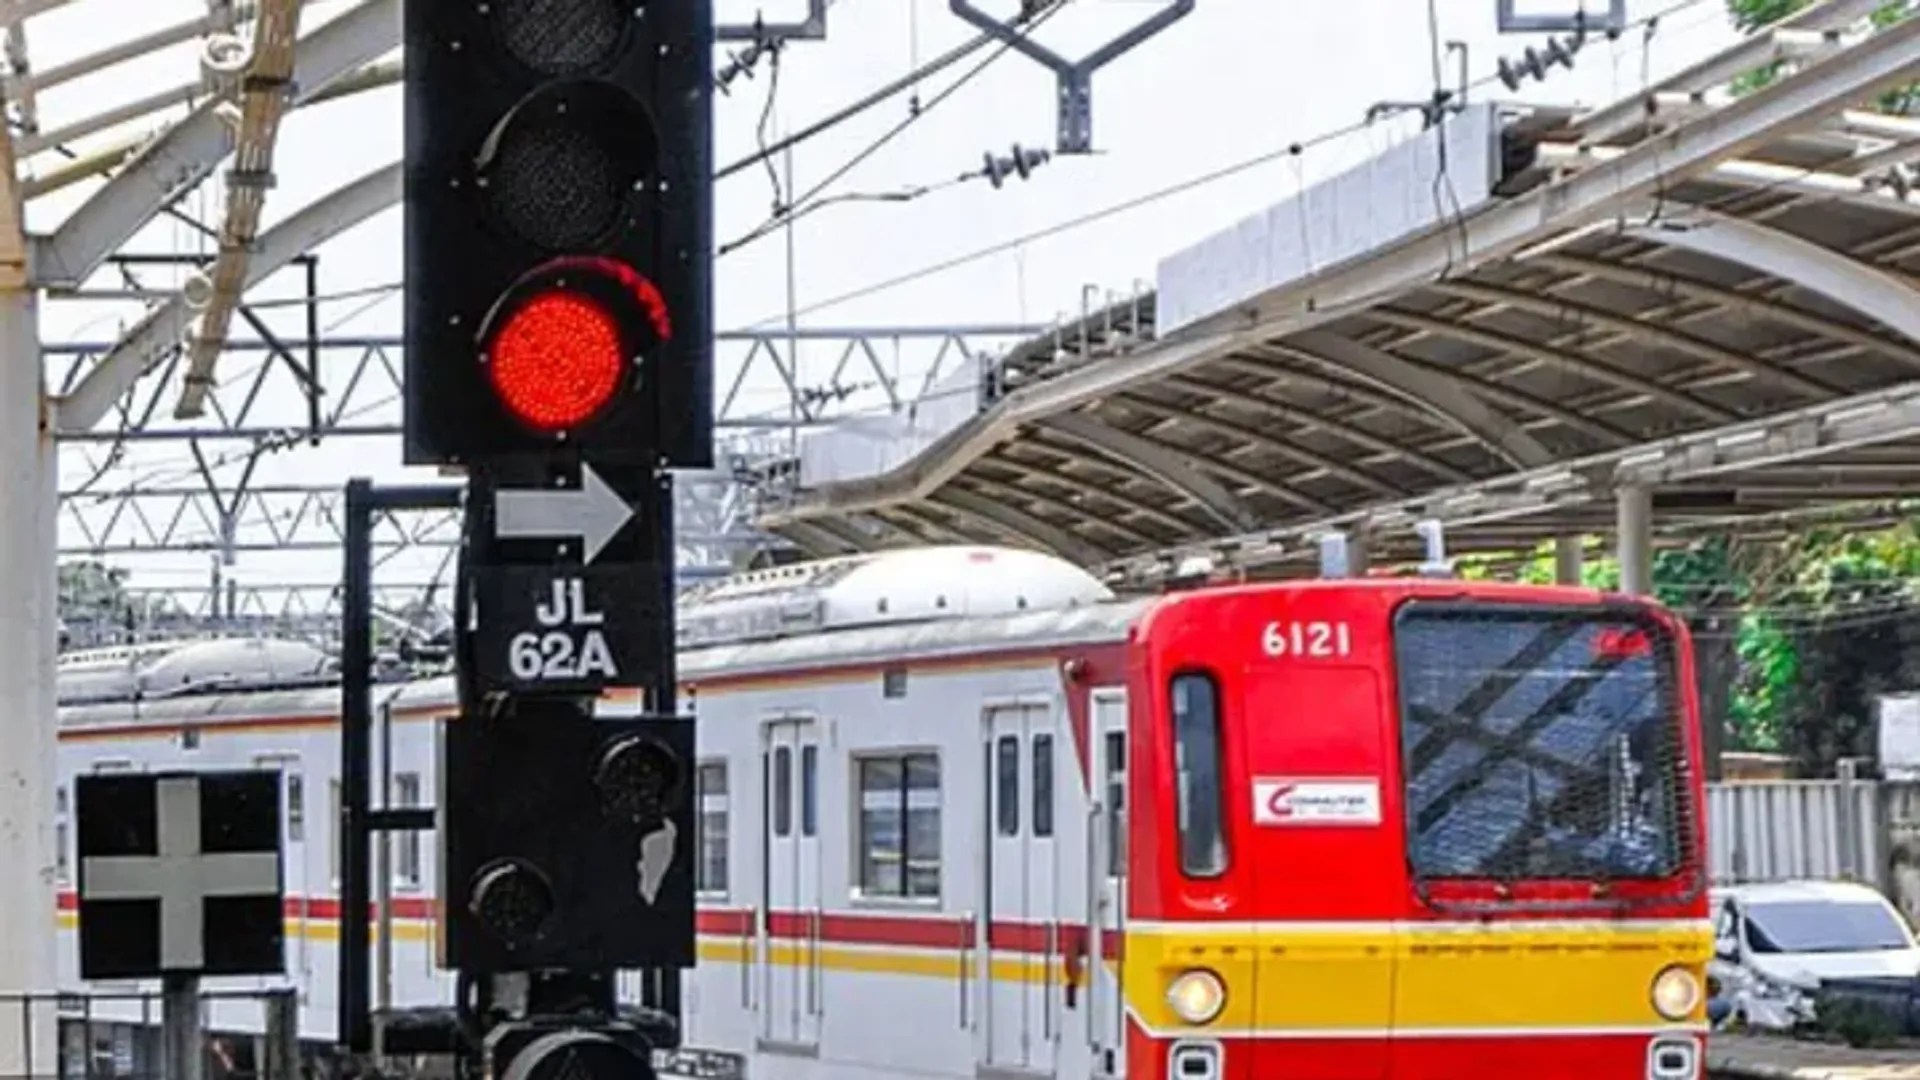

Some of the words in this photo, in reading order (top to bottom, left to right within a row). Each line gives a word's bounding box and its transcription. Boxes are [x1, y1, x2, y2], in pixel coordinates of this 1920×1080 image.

[536, 579, 604, 625] JL
[509, 631, 618, 680] 62A
[1261, 621, 1350, 656] 6121
